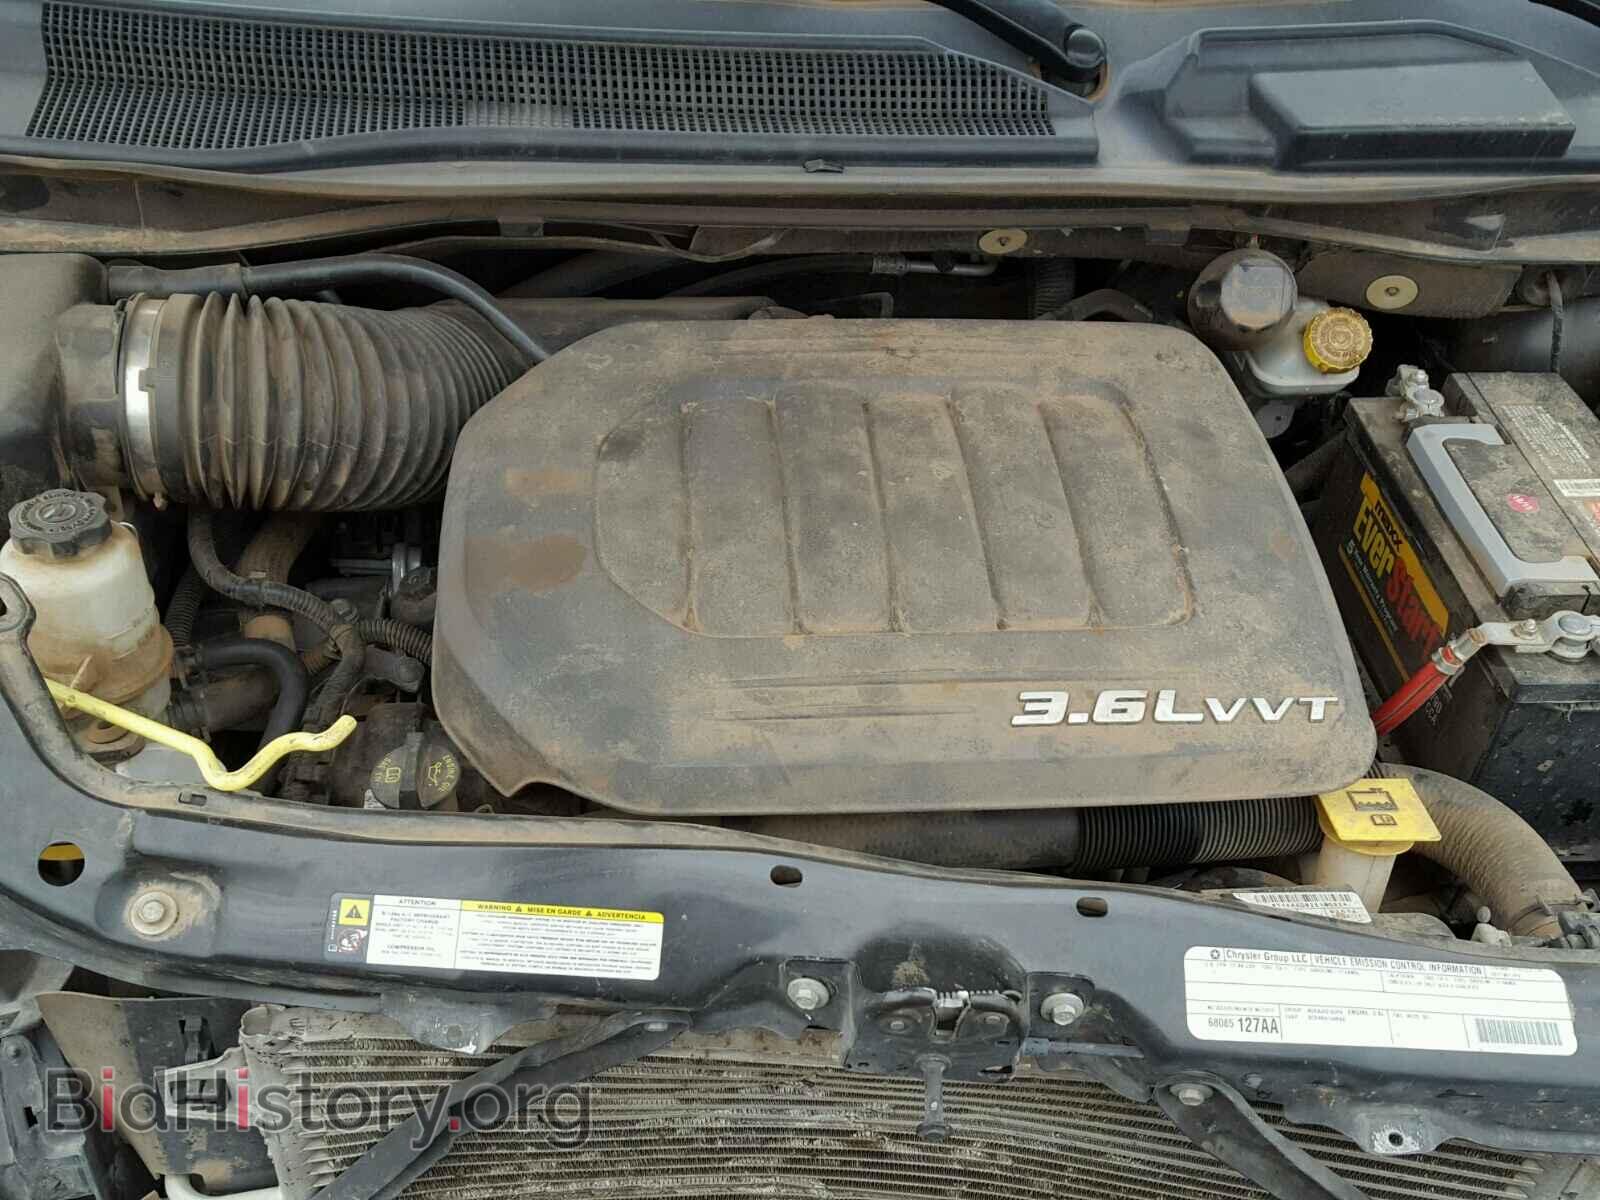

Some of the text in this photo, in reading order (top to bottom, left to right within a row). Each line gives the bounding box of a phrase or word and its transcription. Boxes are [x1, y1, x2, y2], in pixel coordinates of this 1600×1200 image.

[477, 903, 512, 912] WARNING
[527, 906, 545, 914] MISE
[557, 908, 582, 917] GARDE
[597, 911, 646, 921] ADVERTENCIA
[1226, 949, 1261, 961] Chrysler
[1263, 952, 1289, 963] Group
[1291, 954, 1308, 964] LLC
[1314, 955, 1346, 966] VEHICLE
[1350, 957, 1387, 969] EMISSION
[1391, 960, 1425, 970] CONTROL
[1428, 963, 1482, 975] INFORMATION
[1238, 1017, 1279, 1034] 127AA
